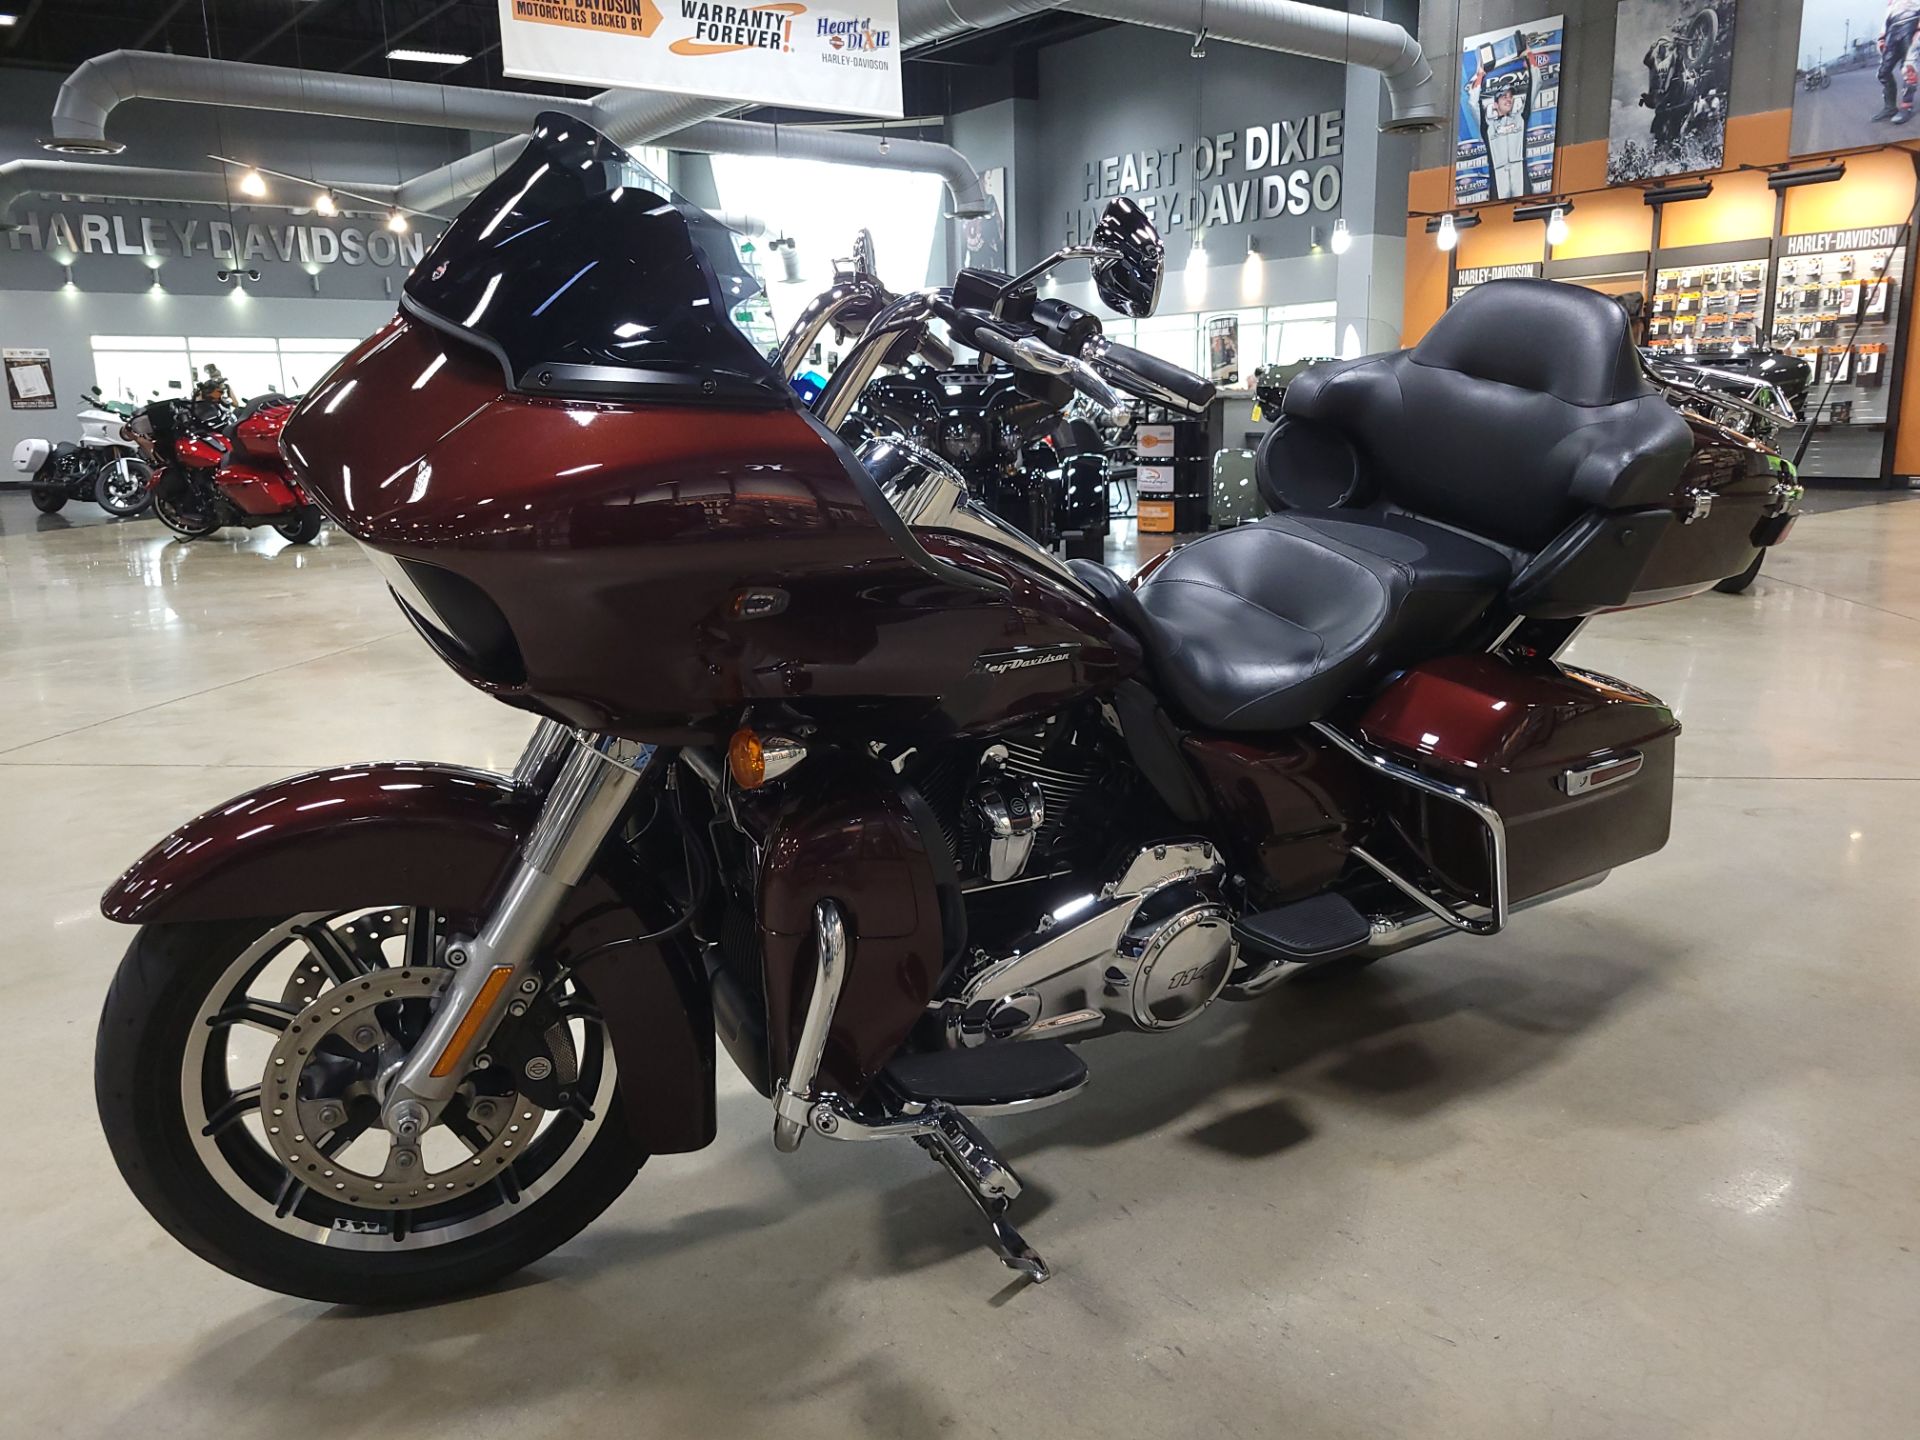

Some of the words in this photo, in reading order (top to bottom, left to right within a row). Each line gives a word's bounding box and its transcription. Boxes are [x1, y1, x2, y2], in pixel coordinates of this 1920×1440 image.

[517, 1, 587, 24] MOTORCYCLES
[591, 11, 627, 29] BACKED
[631, 17, 643, 31] BY
[681, 0, 785, 30] WARRANTY
[817, 17, 859, 36] Heart
[861, 17, 871, 30] of
[847, 30, 890, 52] DIXIE
[821, 52, 889, 71] HARLEY-DAVIDSON
[1083, 143, 1181, 201] HEART
[1194, 131, 1235, 181] OF
[1245, 109, 1343, 171] DIXIE
[8, 211, 426, 268] HARLEY-DAVIDSON
[1787, 226, 1898, 255] HARLEY-DAVIDSON
[1458, 264, 1534, 286] HARLEY-DAVIDSON
